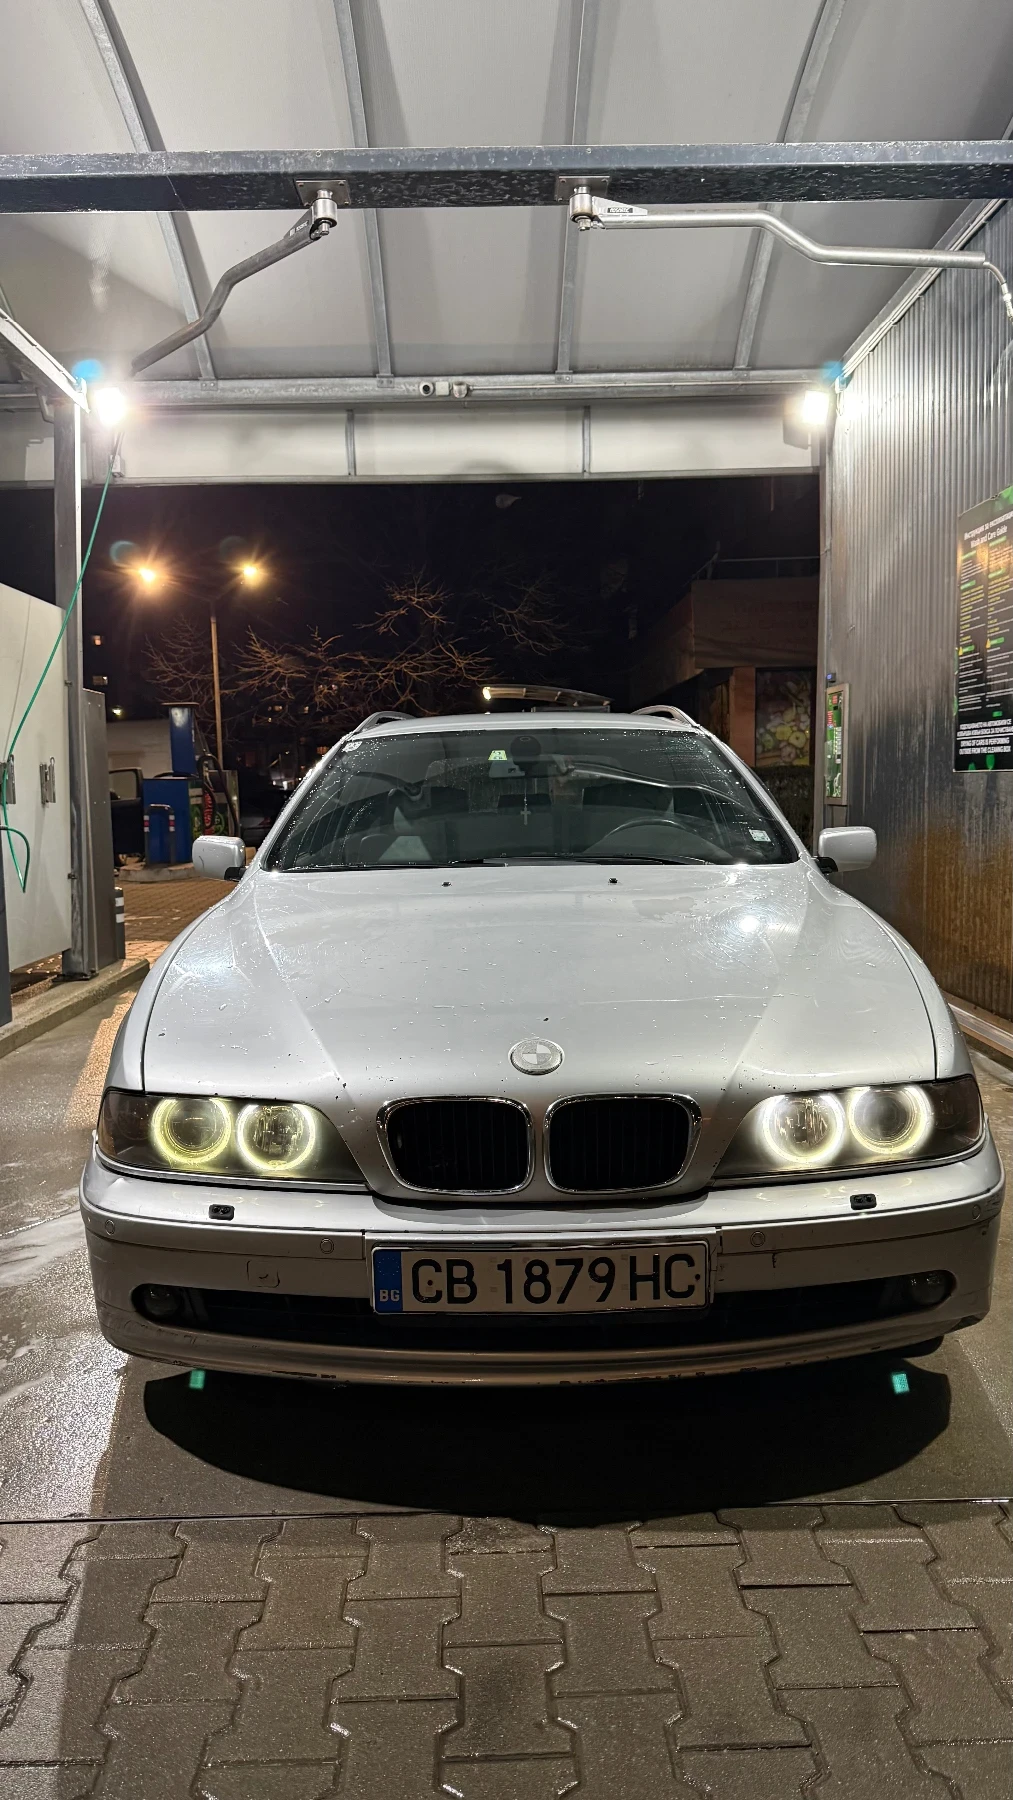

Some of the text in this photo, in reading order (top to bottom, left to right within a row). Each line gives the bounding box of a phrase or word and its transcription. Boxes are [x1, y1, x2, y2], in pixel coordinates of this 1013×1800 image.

[411, 1252, 697, 1305] CB 1879 HC
[379, 1289, 400, 1303] BG
